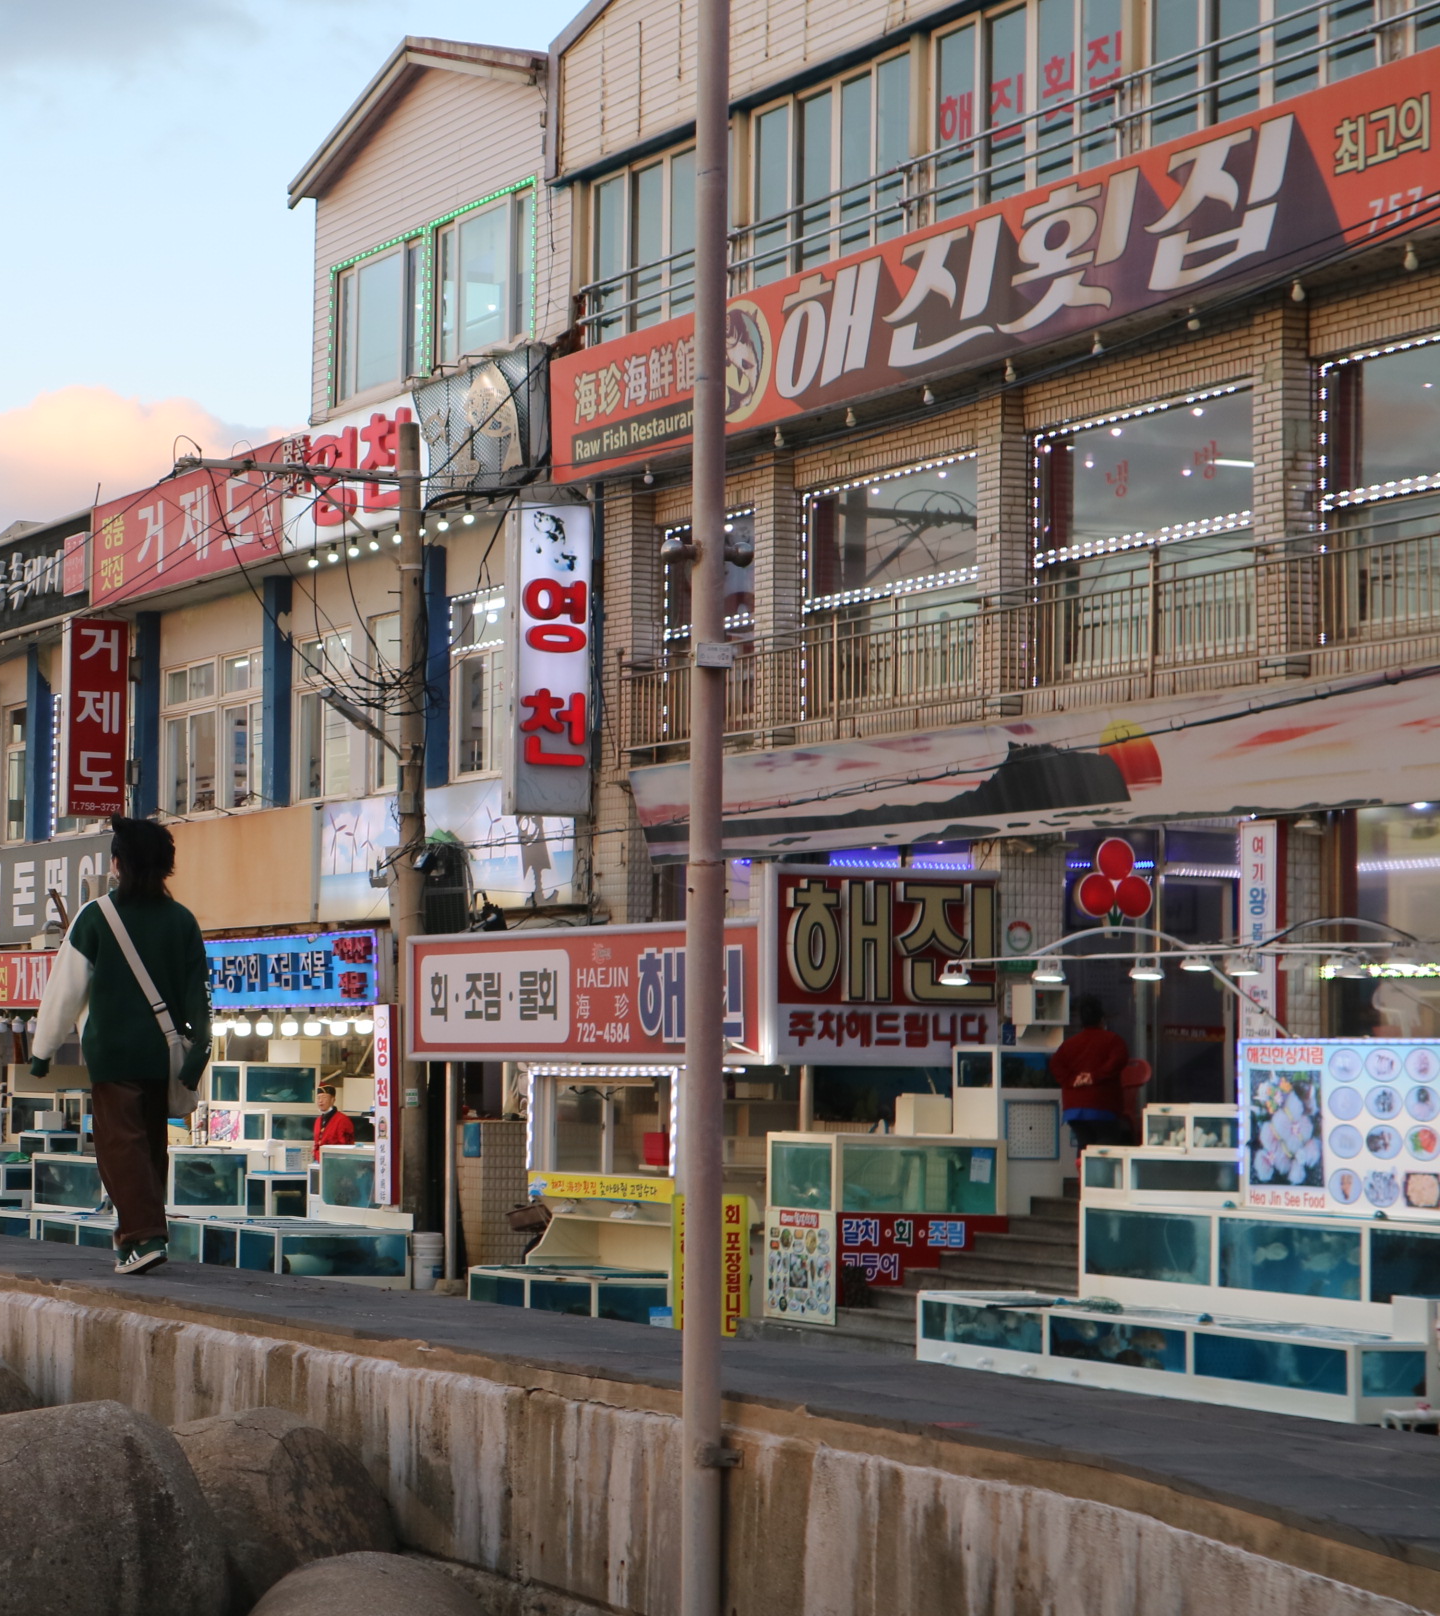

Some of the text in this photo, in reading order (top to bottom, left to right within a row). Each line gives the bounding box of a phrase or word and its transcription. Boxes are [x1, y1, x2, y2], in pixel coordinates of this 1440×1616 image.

[1334, 92, 1431, 177] 최고의
[775, 112, 1294, 399] 해진횟집
[575, 409, 694, 461] Raw Fish Restauran
[101, 512, 125, 549] 명품
[137, 470, 254, 574] 거제도
[100, 553, 124, 591] 맛집
[520, 577, 587, 767] 영천
[74, 628, 120, 793] 거제도
[786, 878, 996, 1003] 해진
[11, 955, 57, 1001] 거제
[213, 950, 326, 993] 고등어회 조림 전복
[576, 966, 629, 989] HAEJIN
[576, 1022, 630, 1045] 722-4584
[1247, 1046, 1325, 1065] 해진한상차림
[376, 1037, 389, 1107] 영천
[725, 1204, 740, 1224] 회
[1269, 1190, 1281, 1206] Jin
[1284, 1191, 1301, 1207] See
[1303, 1193, 1326, 1208] Food
[842, 1218, 879, 1247] 갈치
[894, 1218, 913, 1247] 회
[927, 1220, 966, 1248] 조림
